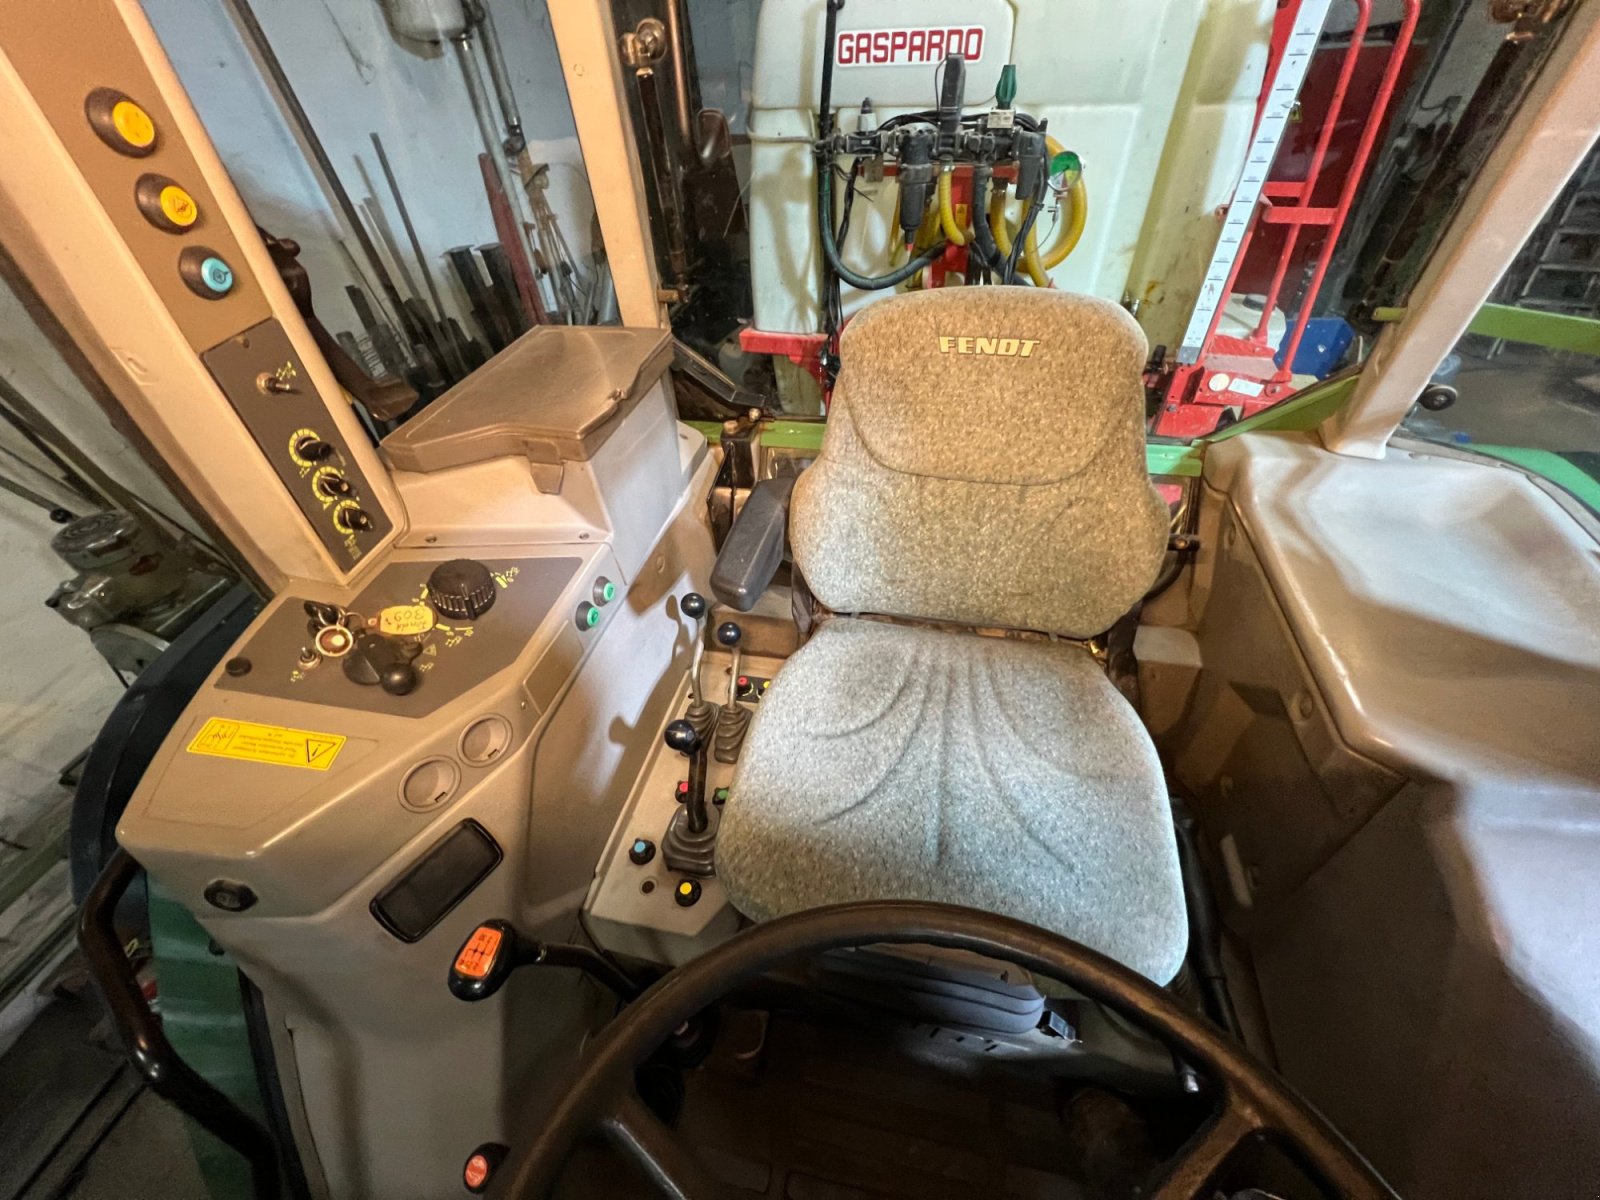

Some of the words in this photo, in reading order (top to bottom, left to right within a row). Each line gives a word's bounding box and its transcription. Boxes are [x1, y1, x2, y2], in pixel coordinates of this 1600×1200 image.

[838, 28, 983, 64] GASPARDO
[940, 336, 1040, 357] FENDT
[394, 608, 425, 622] 309
